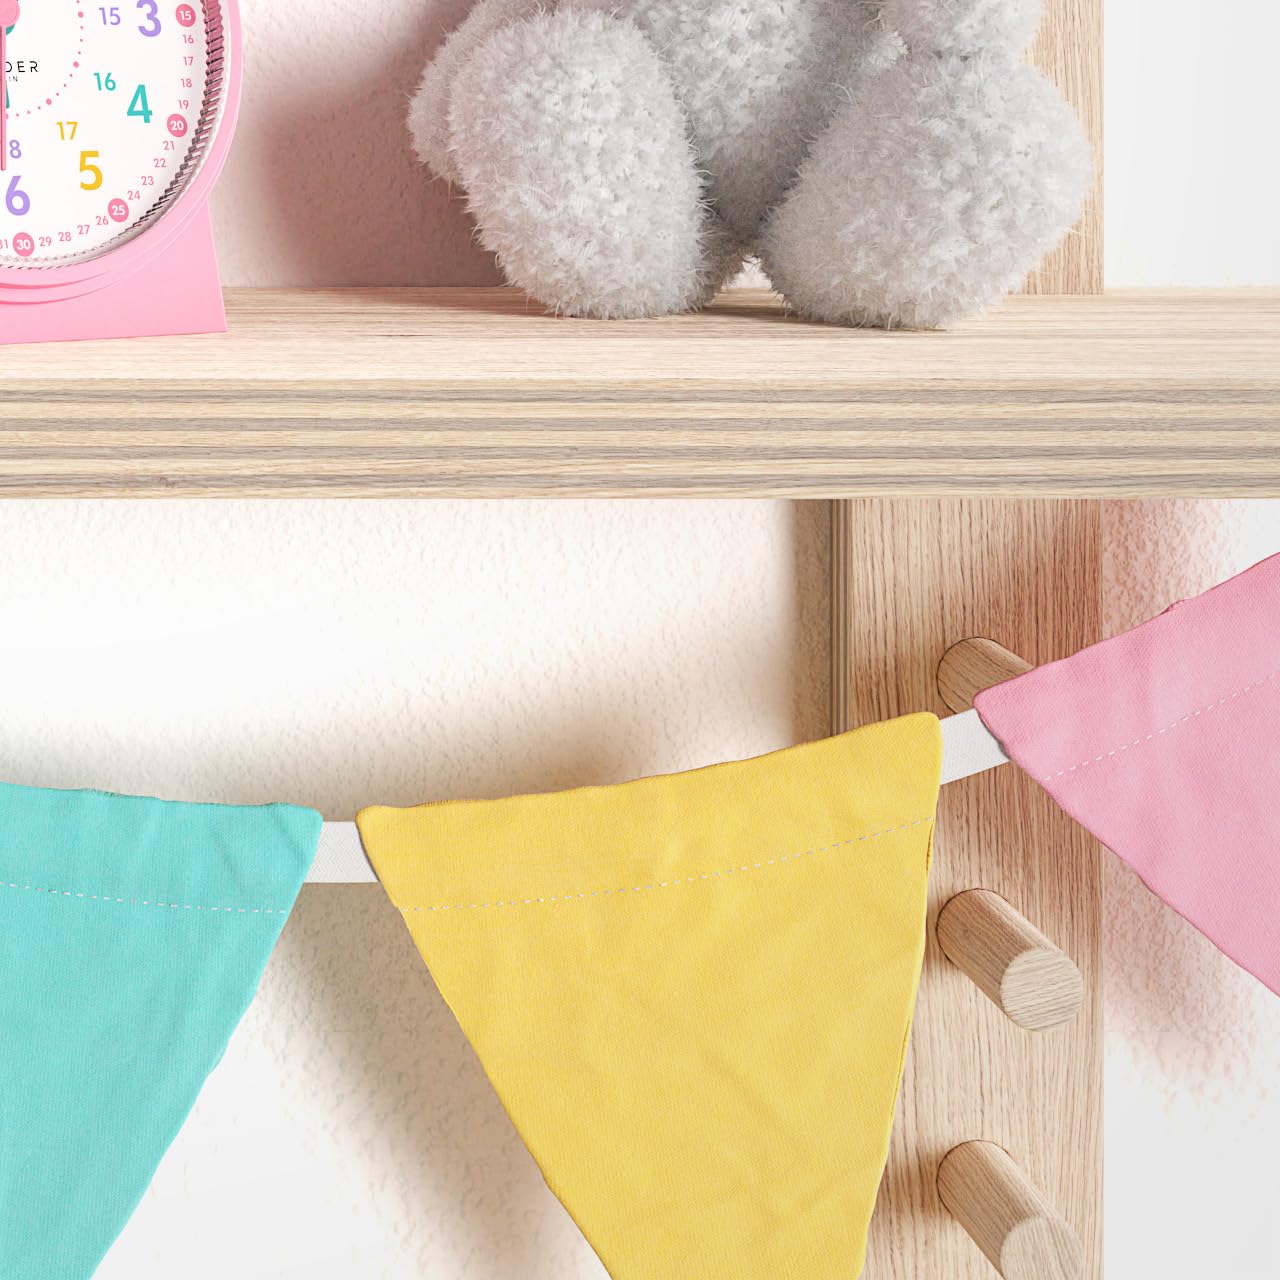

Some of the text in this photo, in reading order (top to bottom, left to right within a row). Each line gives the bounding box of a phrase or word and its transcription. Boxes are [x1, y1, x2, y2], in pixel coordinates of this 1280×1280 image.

[99, 7, 121, 26] 15
[180, 11, 192, 21] 15
[182, 35, 194, 44] 16
[183, 57, 194, 66] 17
[93, 72, 117, 91] 16
[181, 79, 192, 88] 18
[127, 84, 153, 124] 4
[178, 100, 189, 110] 19
[56, 121, 78, 141] 17
[171, 121, 184, 131] 20
[163, 141, 175, 150] 21
[153, 158, 167, 168] 22
[80, 151, 103, 191] 5
[141, 176, 154, 186] 23
[5, 175, 31, 216] 6
[127, 190, 140, 200] 24
[112, 205, 126, 216] 25
[96, 216, 109, 226] 26
[77, 225, 90, 235] 27
[39, 237, 52, 247] 29
[58, 232, 72, 242] 28
[17, 239, 31, 250] 30
